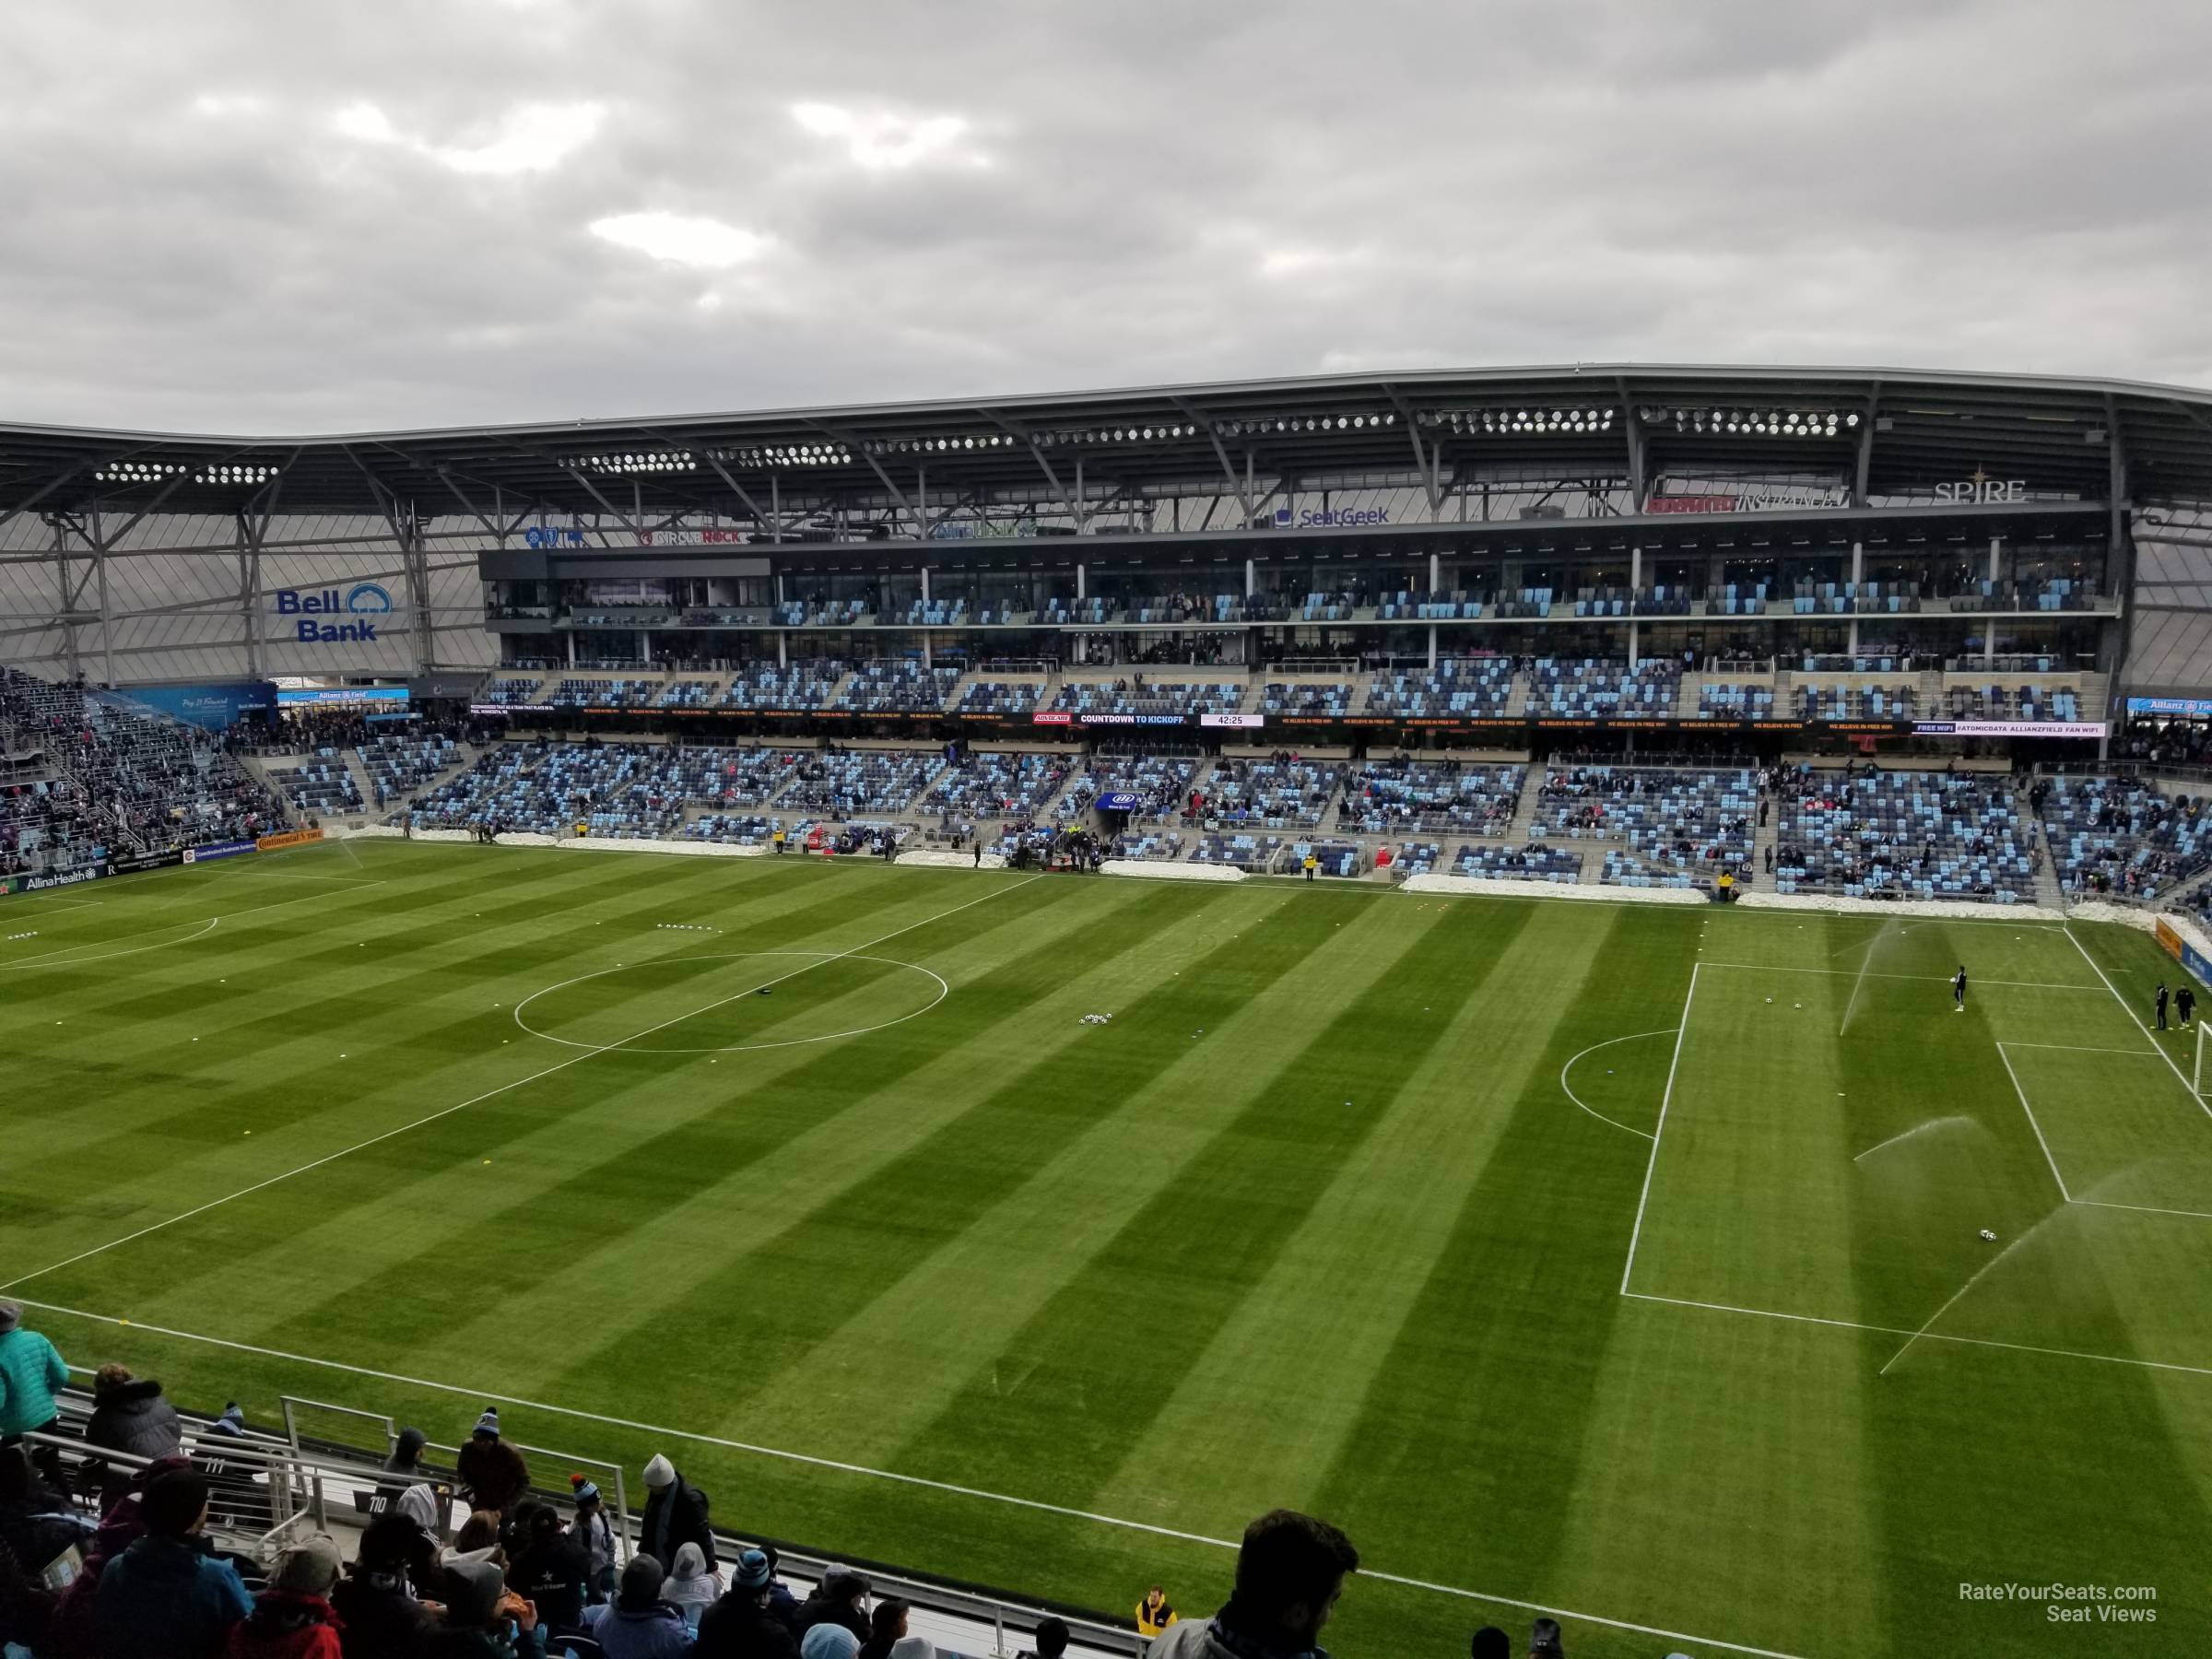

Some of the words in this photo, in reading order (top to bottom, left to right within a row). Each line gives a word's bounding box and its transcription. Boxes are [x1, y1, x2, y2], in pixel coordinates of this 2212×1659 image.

[1935, 480, 2026, 504] SPIRE
[1300, 507, 1390, 526] SeatGeek
[277, 590, 340, 615] Bell
[298, 618, 377, 642] Bank
[2151, 700, 2183, 710] Allianz
[1135, 715, 1147, 724] TO
[1218, 716, 1242, 724] 42:25
[259, 833, 300, 849] Continental
[108, 865, 117, 876] R
[370, 1496, 387, 1512] 110
